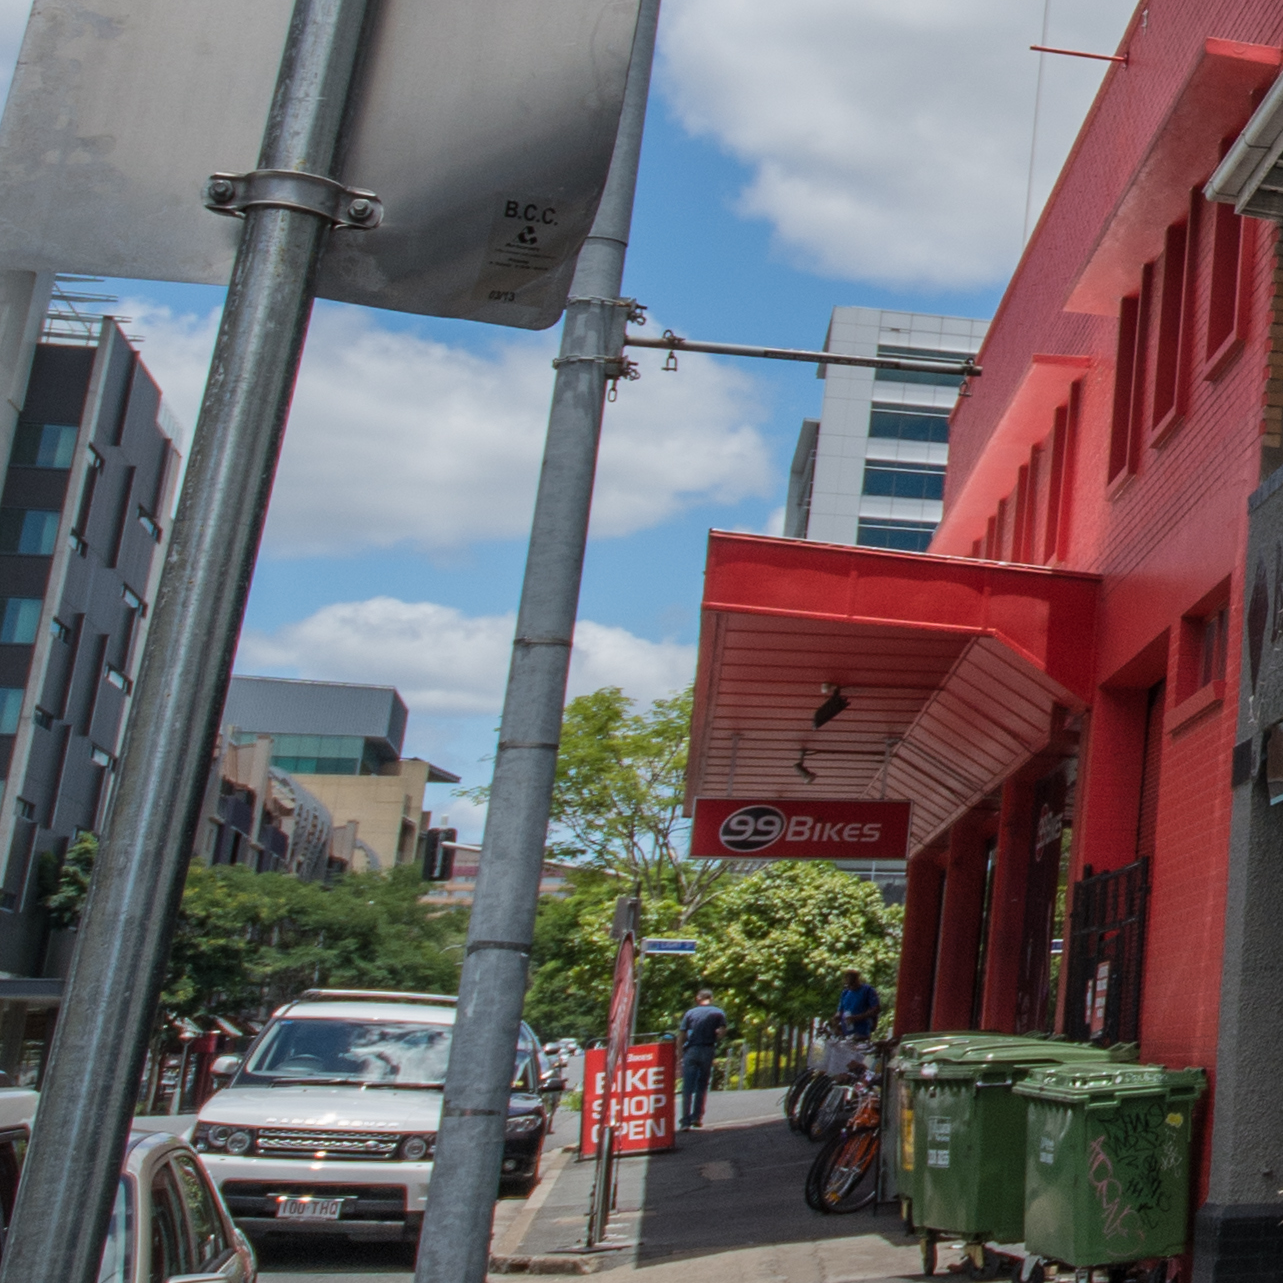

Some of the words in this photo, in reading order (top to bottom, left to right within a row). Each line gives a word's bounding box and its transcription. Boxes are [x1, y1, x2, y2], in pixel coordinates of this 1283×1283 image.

[504, 200, 558, 226] B.C.C.
[721, 814, 783, 842] 99
[594, 1066, 665, 1095] BIKE
